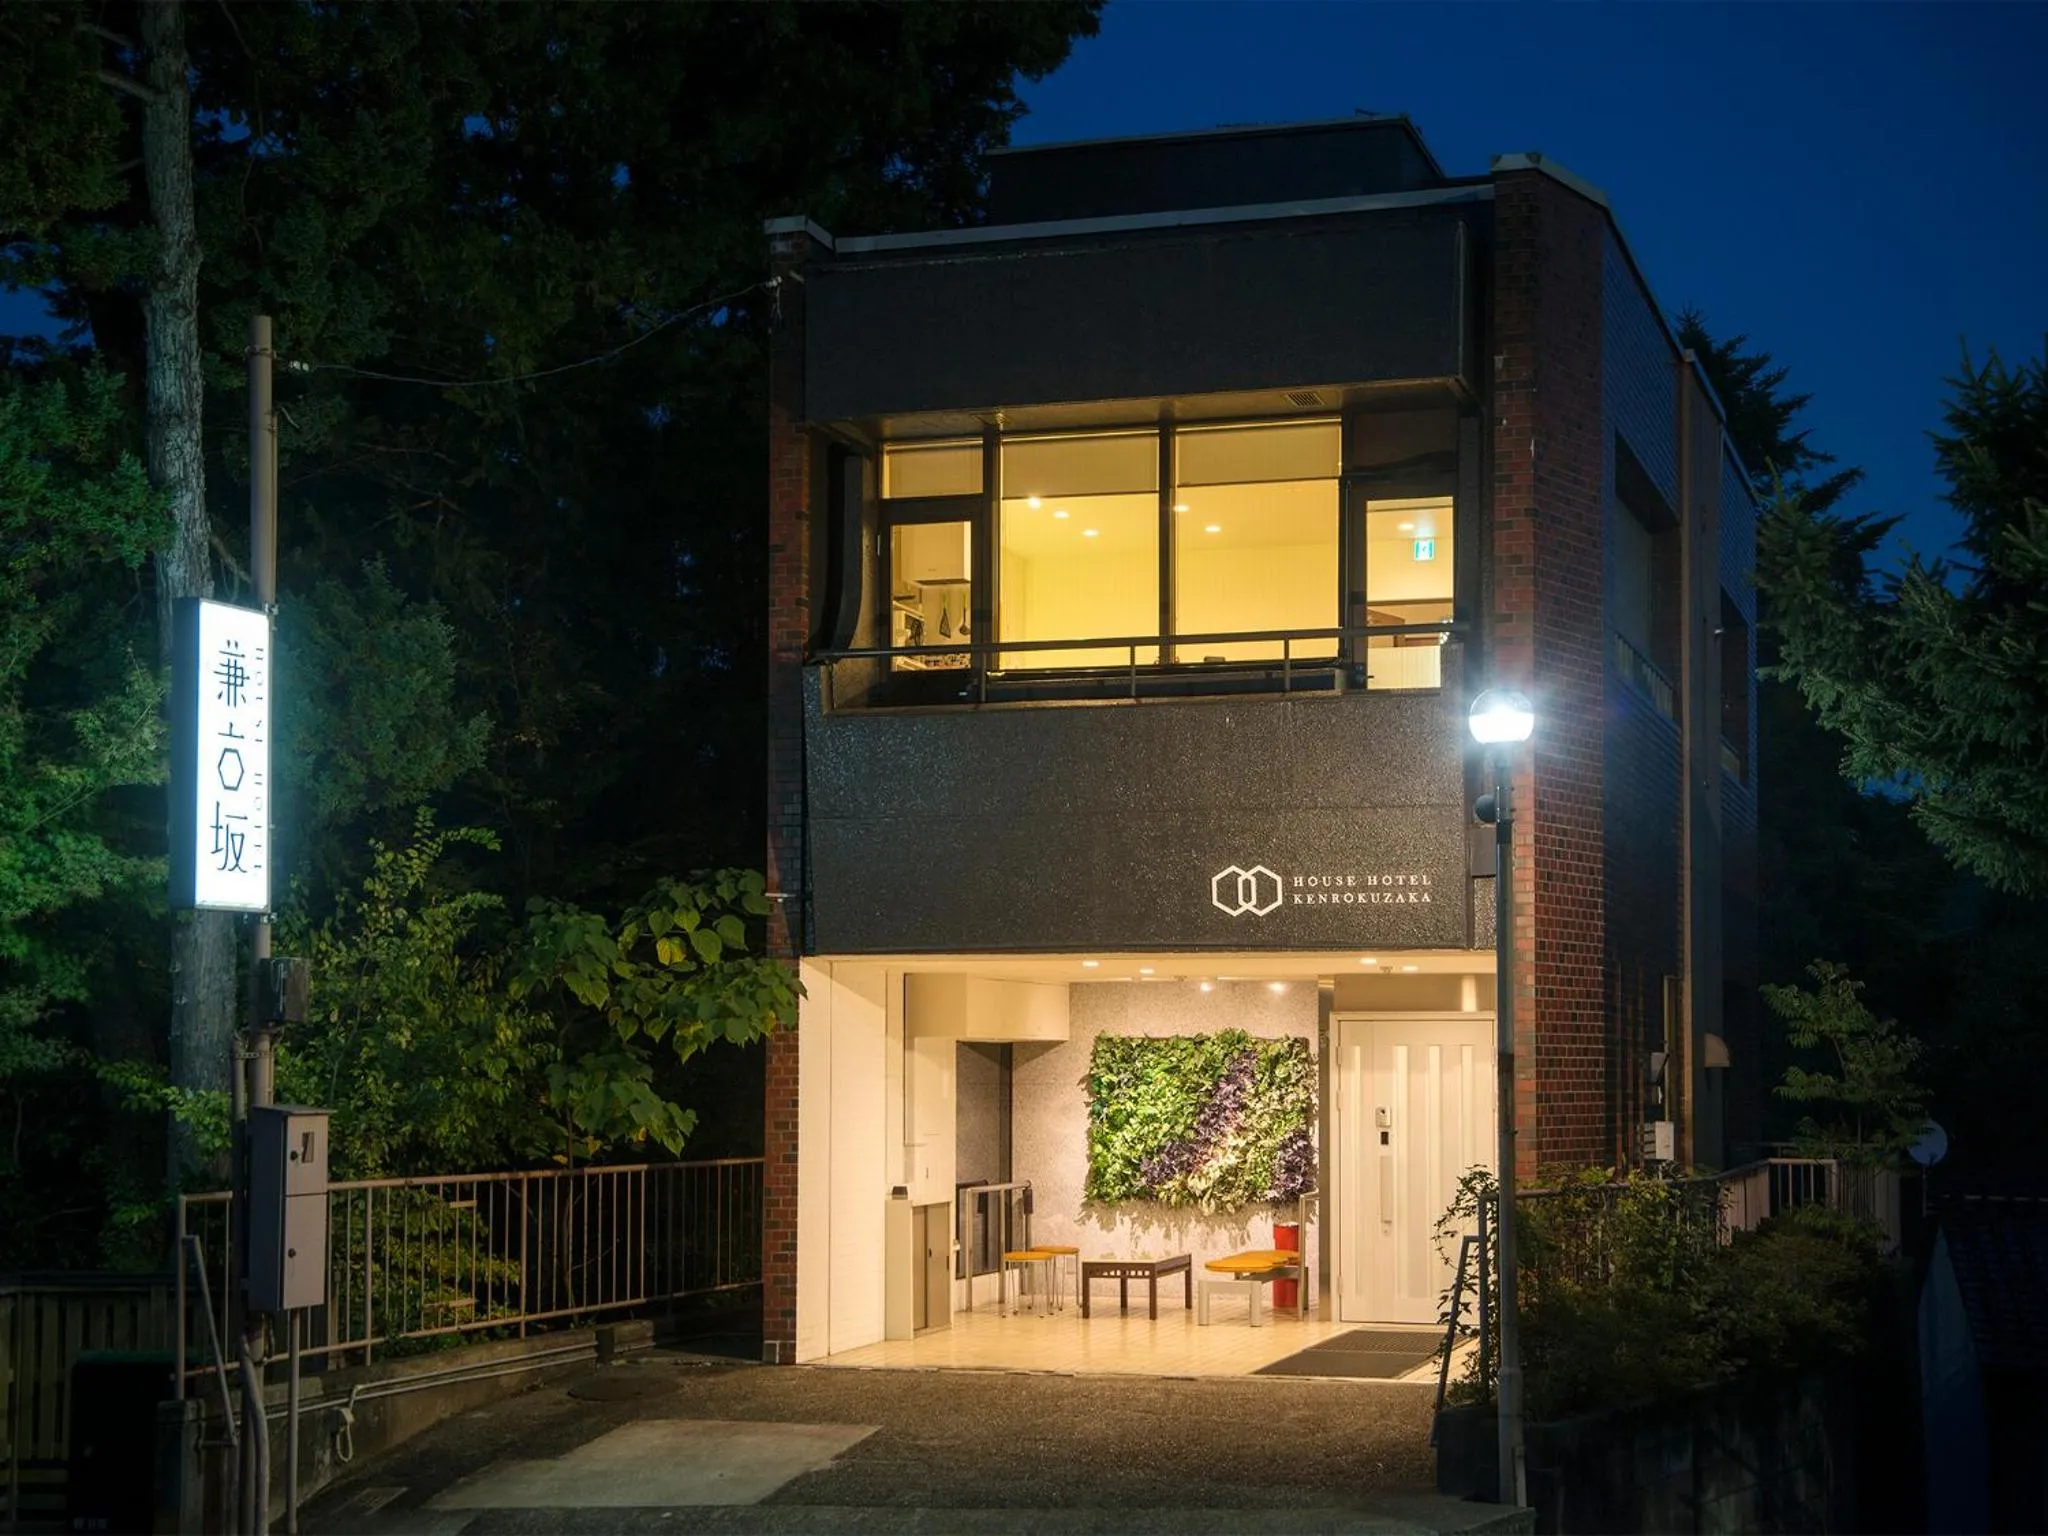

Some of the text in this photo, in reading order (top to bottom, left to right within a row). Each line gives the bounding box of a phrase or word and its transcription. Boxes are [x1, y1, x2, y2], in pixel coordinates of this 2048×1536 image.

[1293, 873, 1432, 888] HOUSE HOTEL
[1293, 891, 1432, 905] KENROKUZAKA
